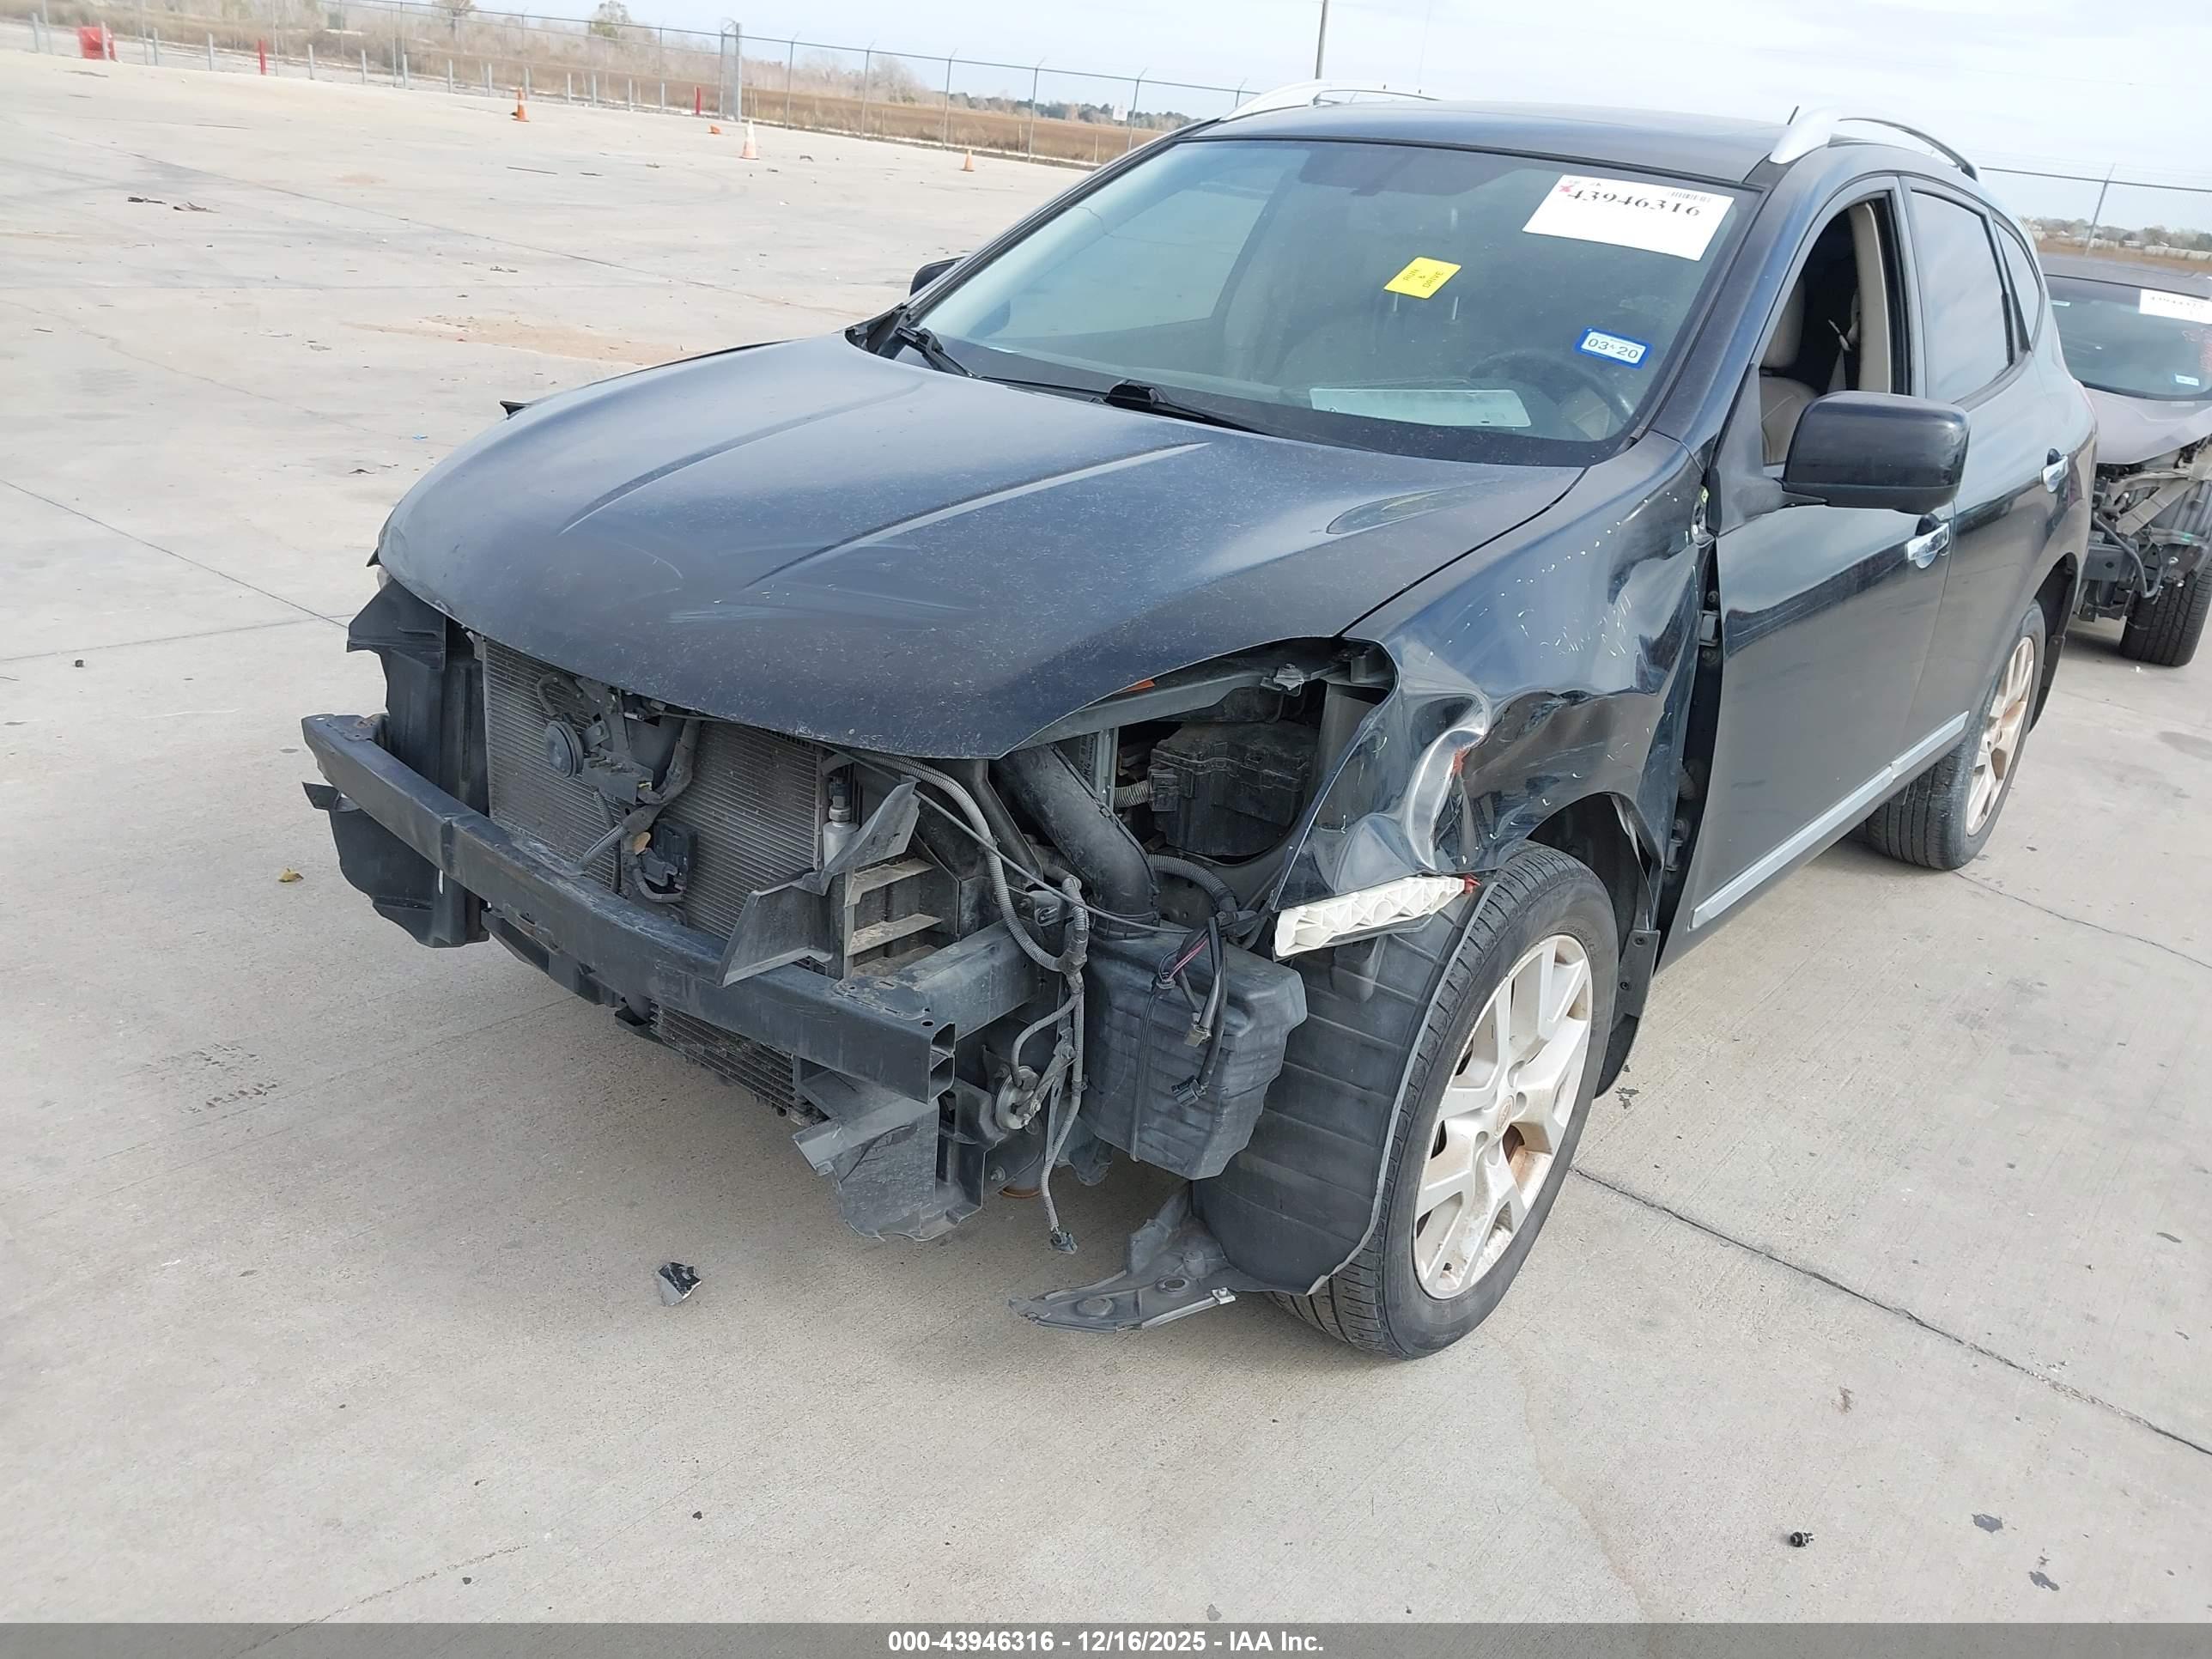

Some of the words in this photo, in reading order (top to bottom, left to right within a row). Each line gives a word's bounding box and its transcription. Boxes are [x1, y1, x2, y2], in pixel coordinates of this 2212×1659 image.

[1566, 189, 1702, 217] 43946316
[1402, 268, 1422, 282] RUN
[1421, 270, 1444, 289] DRIVE
[1587, 337, 1610, 350] 03
[1616, 346, 1639, 359] 20
